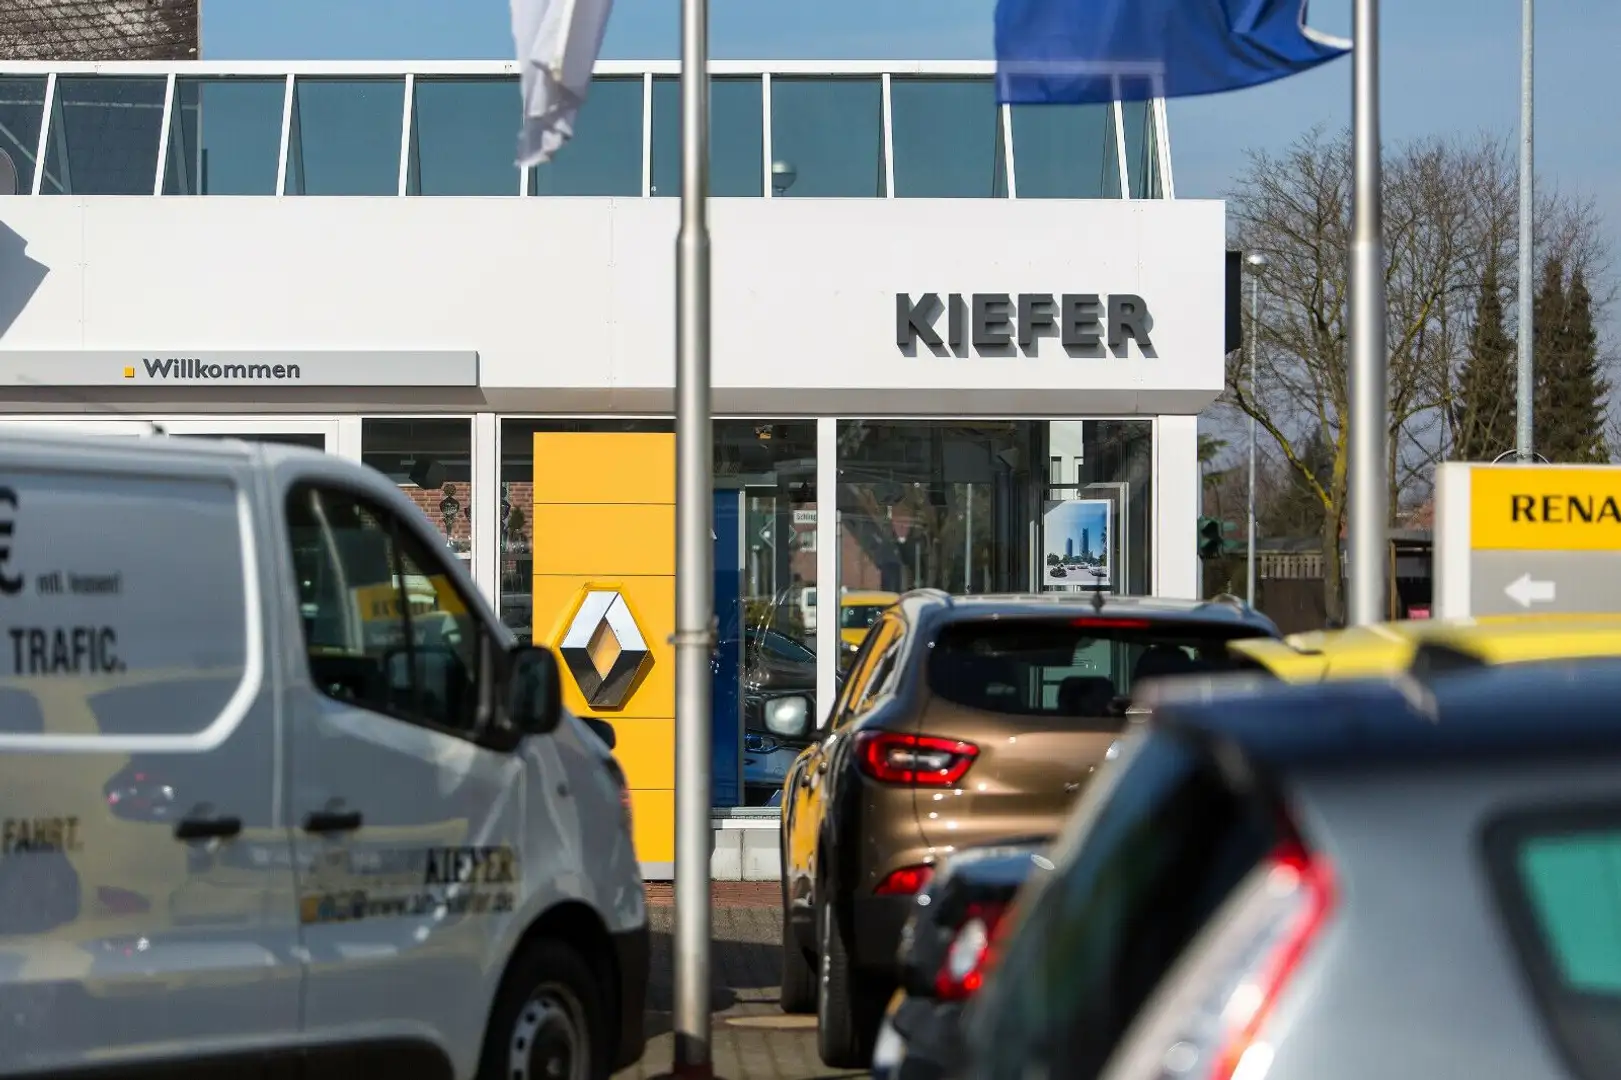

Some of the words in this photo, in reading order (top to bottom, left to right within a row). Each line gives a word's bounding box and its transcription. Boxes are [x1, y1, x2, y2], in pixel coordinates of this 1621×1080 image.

[896, 292, 1154, 348] KIEFER
[142, 357, 300, 379] Willkommen
[1510, 494, 1621, 523] RENA
[9, 625, 127, 675] TRAFIC.
